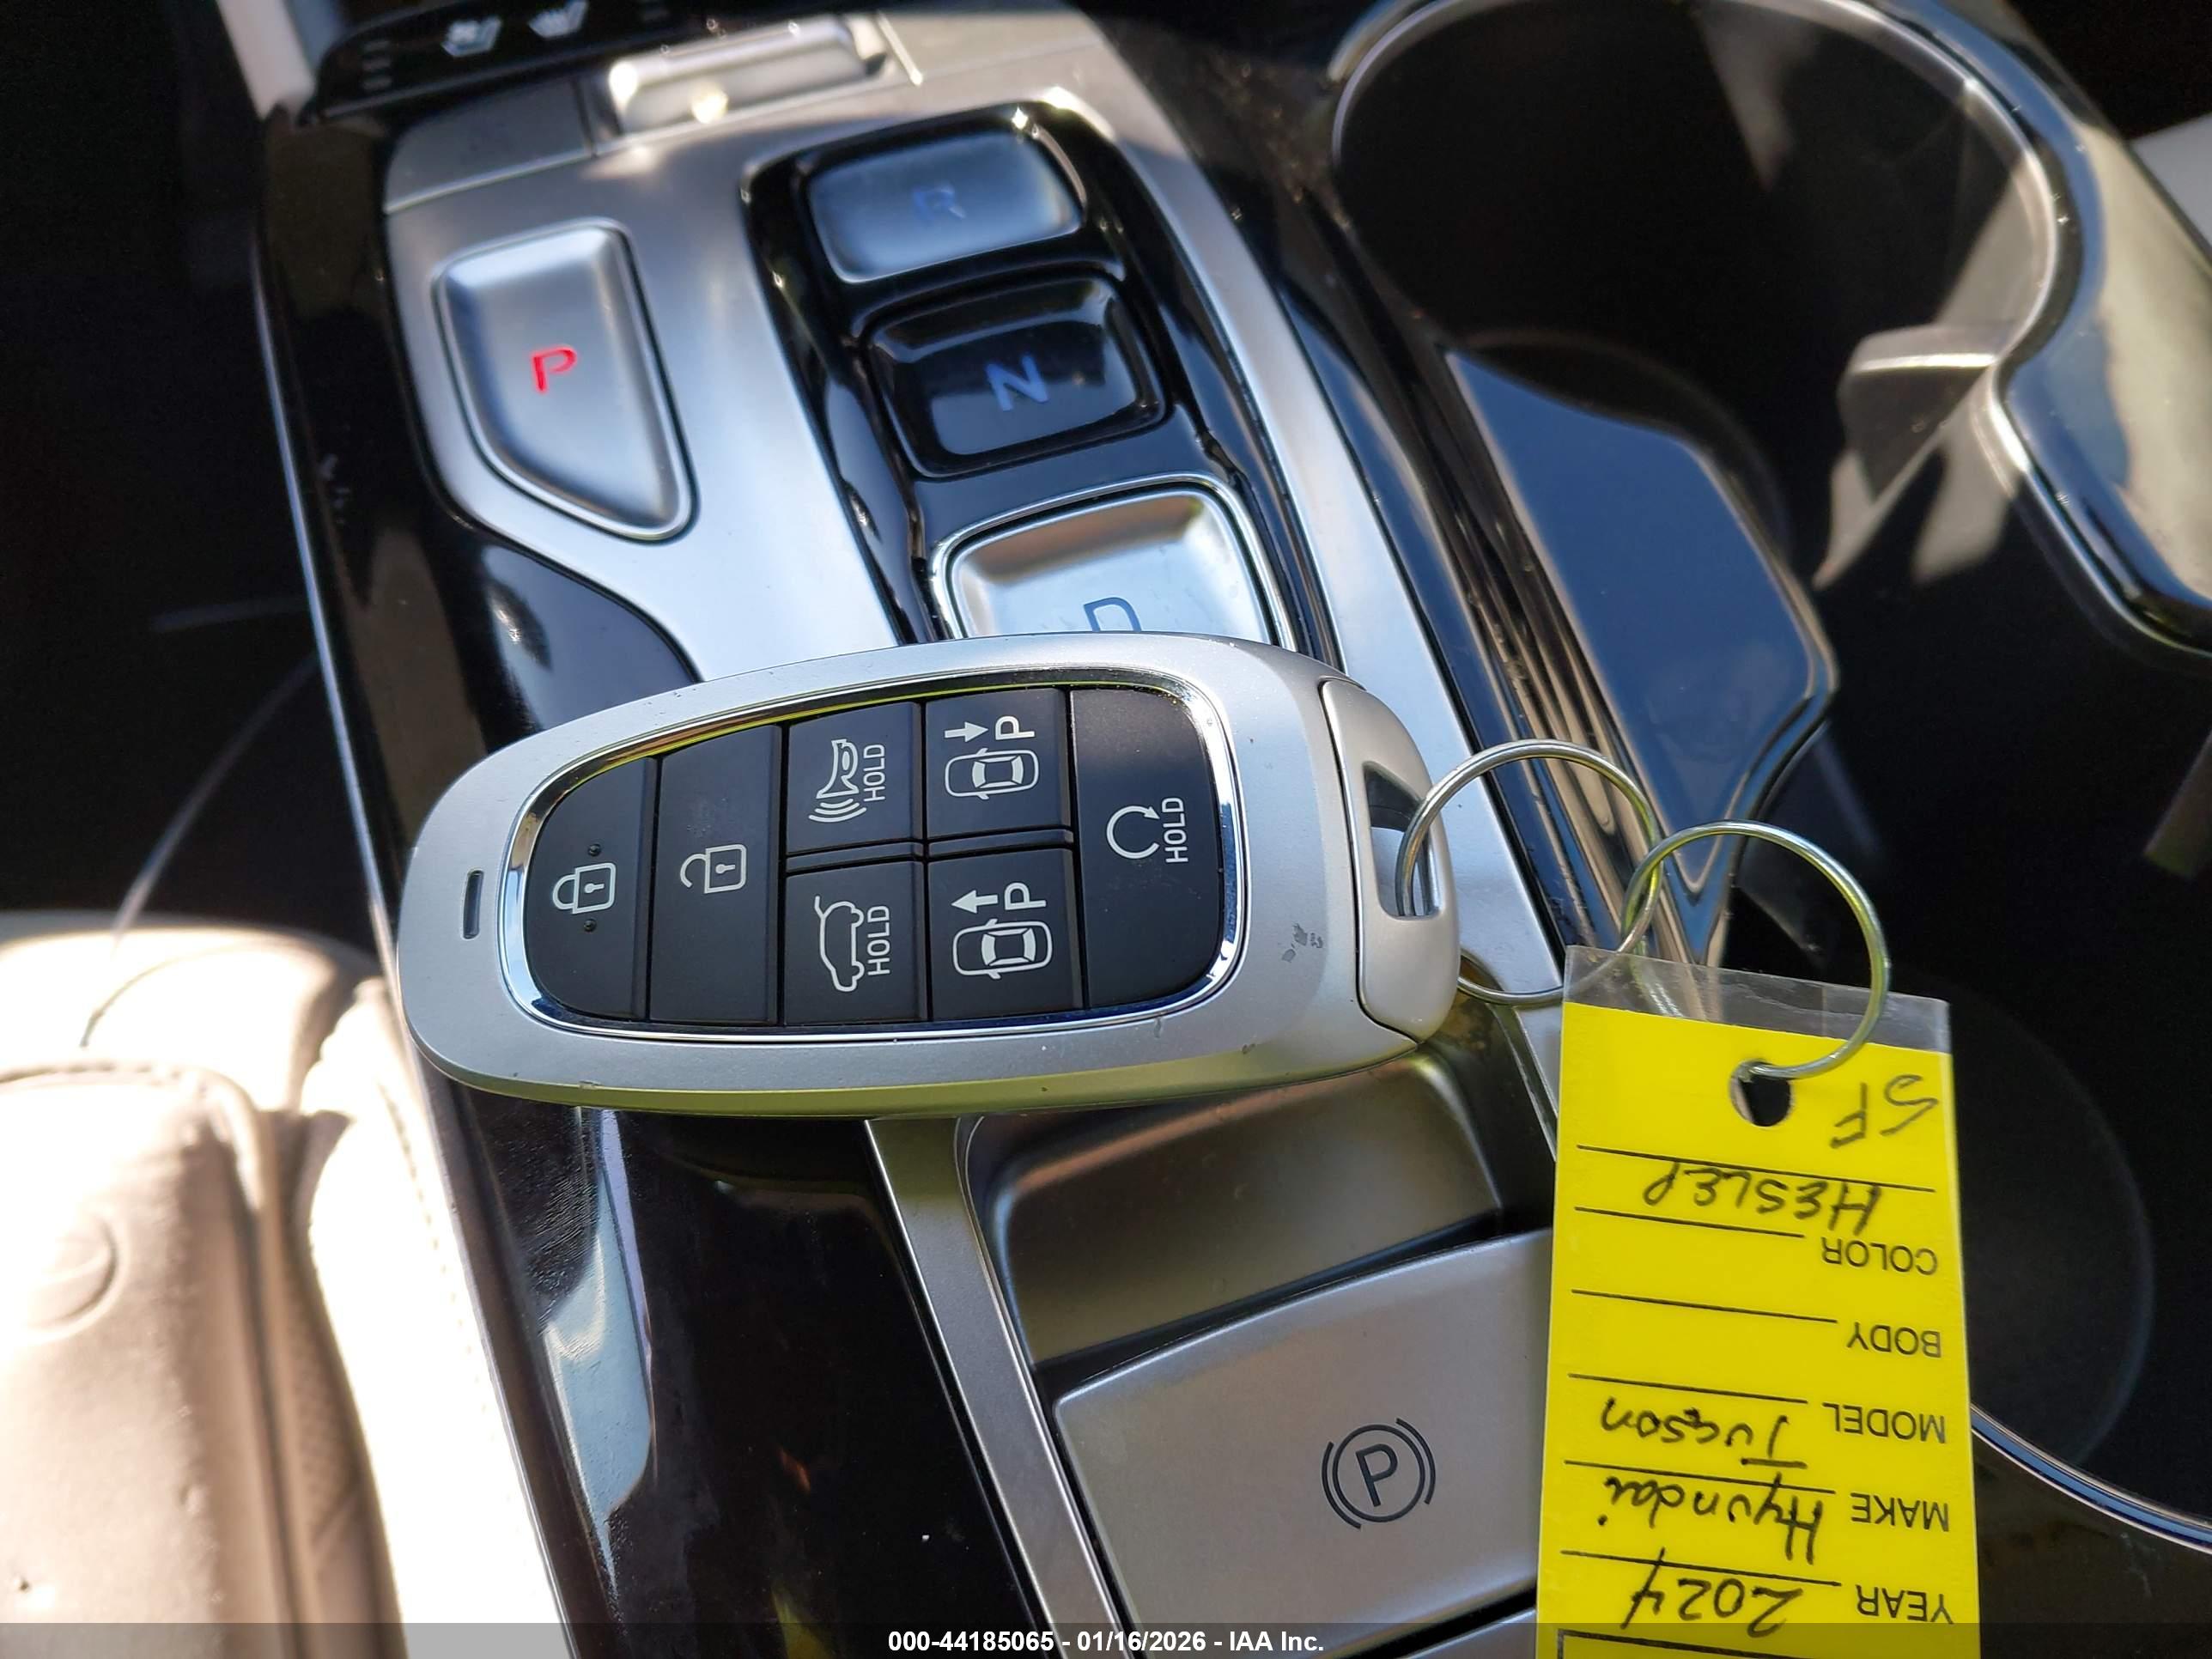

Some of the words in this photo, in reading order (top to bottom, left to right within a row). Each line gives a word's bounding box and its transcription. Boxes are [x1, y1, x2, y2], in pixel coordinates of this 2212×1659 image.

[910, 183, 967, 227] R
[531, 346, 578, 393] P
[985, 354, 1051, 412] N
[994, 714, 1036, 741] P
[863, 744, 885, 802] HOLD
[1162, 797, 1189, 864] HOLD
[1004, 882, 1047, 911] P
[867, 905, 890, 976] HOLD
[1821, 1237, 1938, 1276] COLOR
[1847, 1322, 1942, 1358] BODY
[1822, 1401, 1947, 1444] MODEL
[1355, 1443, 1398, 1507] P
[1597, 1471, 1824, 1565] Hyundai
[1850, 1492, 1950, 1533] MAKE
[1620, 1547, 1804, 1638] 2024
[1855, 1584, 1954, 1625] YEAR
